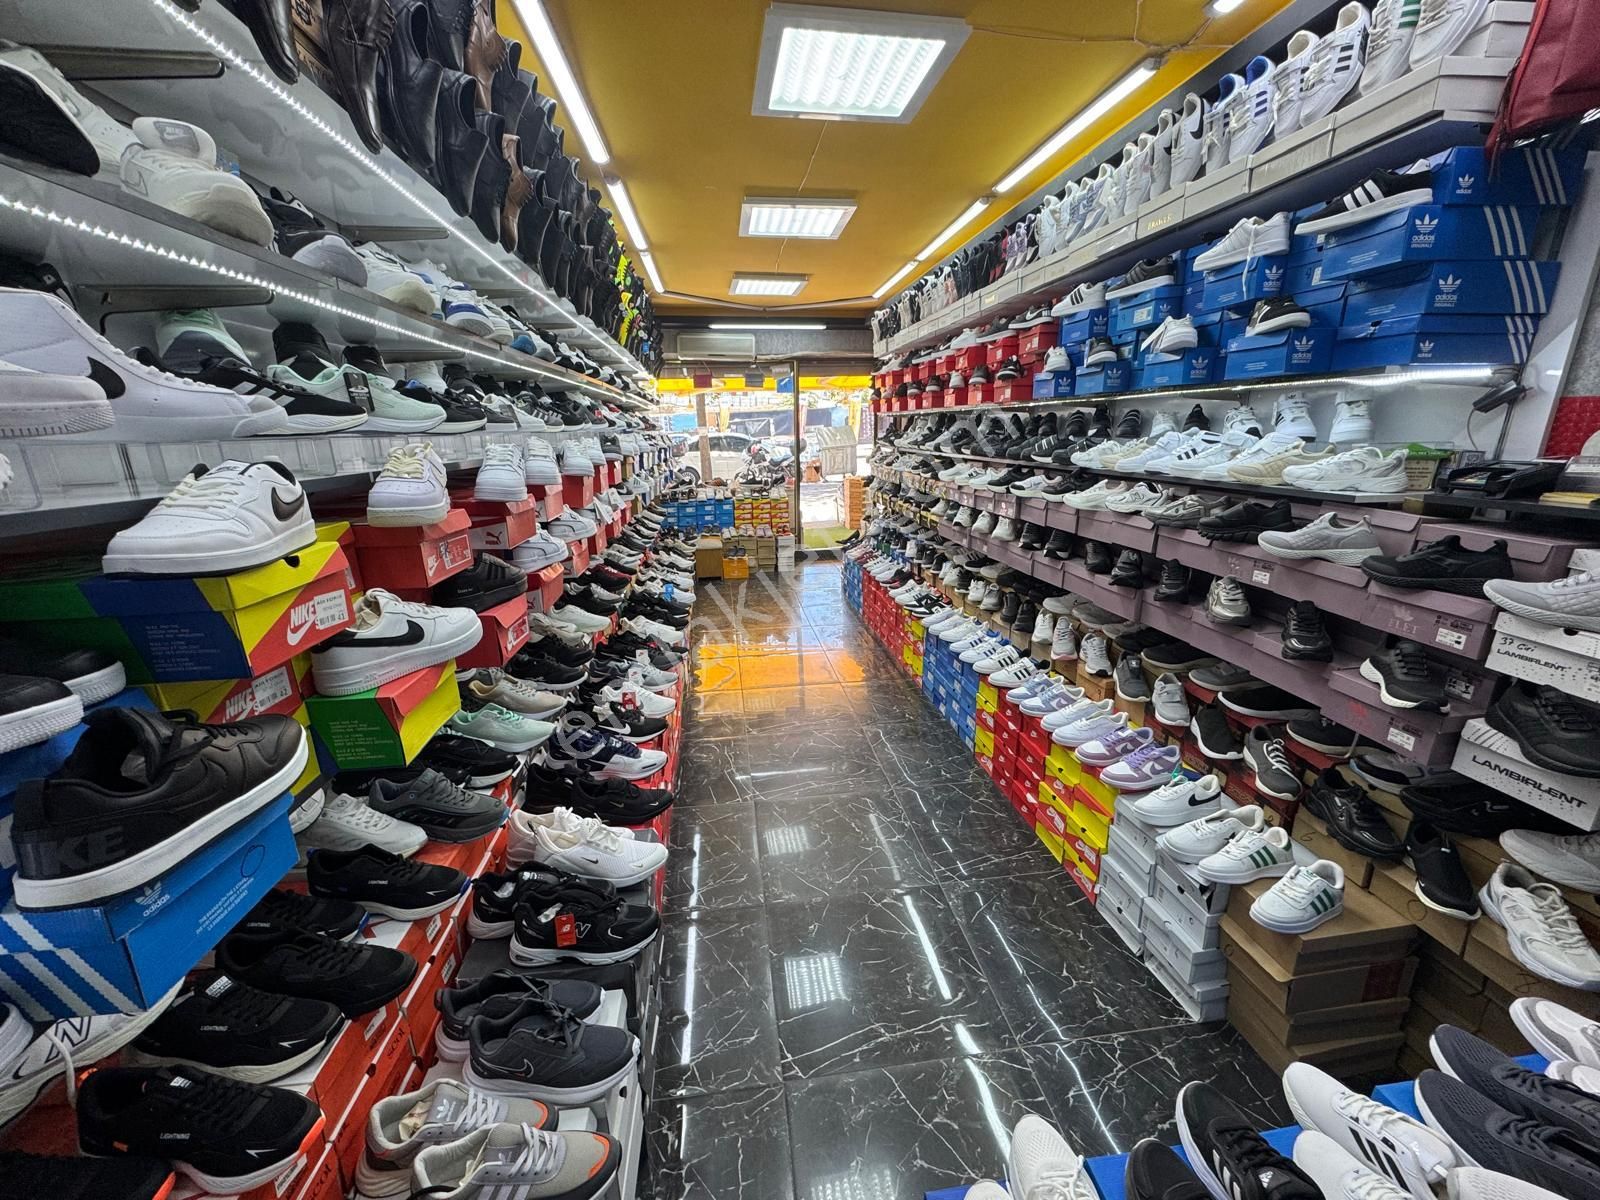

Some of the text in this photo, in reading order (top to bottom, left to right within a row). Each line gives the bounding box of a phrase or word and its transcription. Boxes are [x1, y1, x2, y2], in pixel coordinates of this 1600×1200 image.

[290, 601, 318, 629] NIKE
[1497, 648, 1566, 672] LAMBIRLENT
[225, 690, 254, 719] NIKE
[1471, 754, 1587, 808] LAMBIRLENT
[143, 893, 171, 917] adidas
